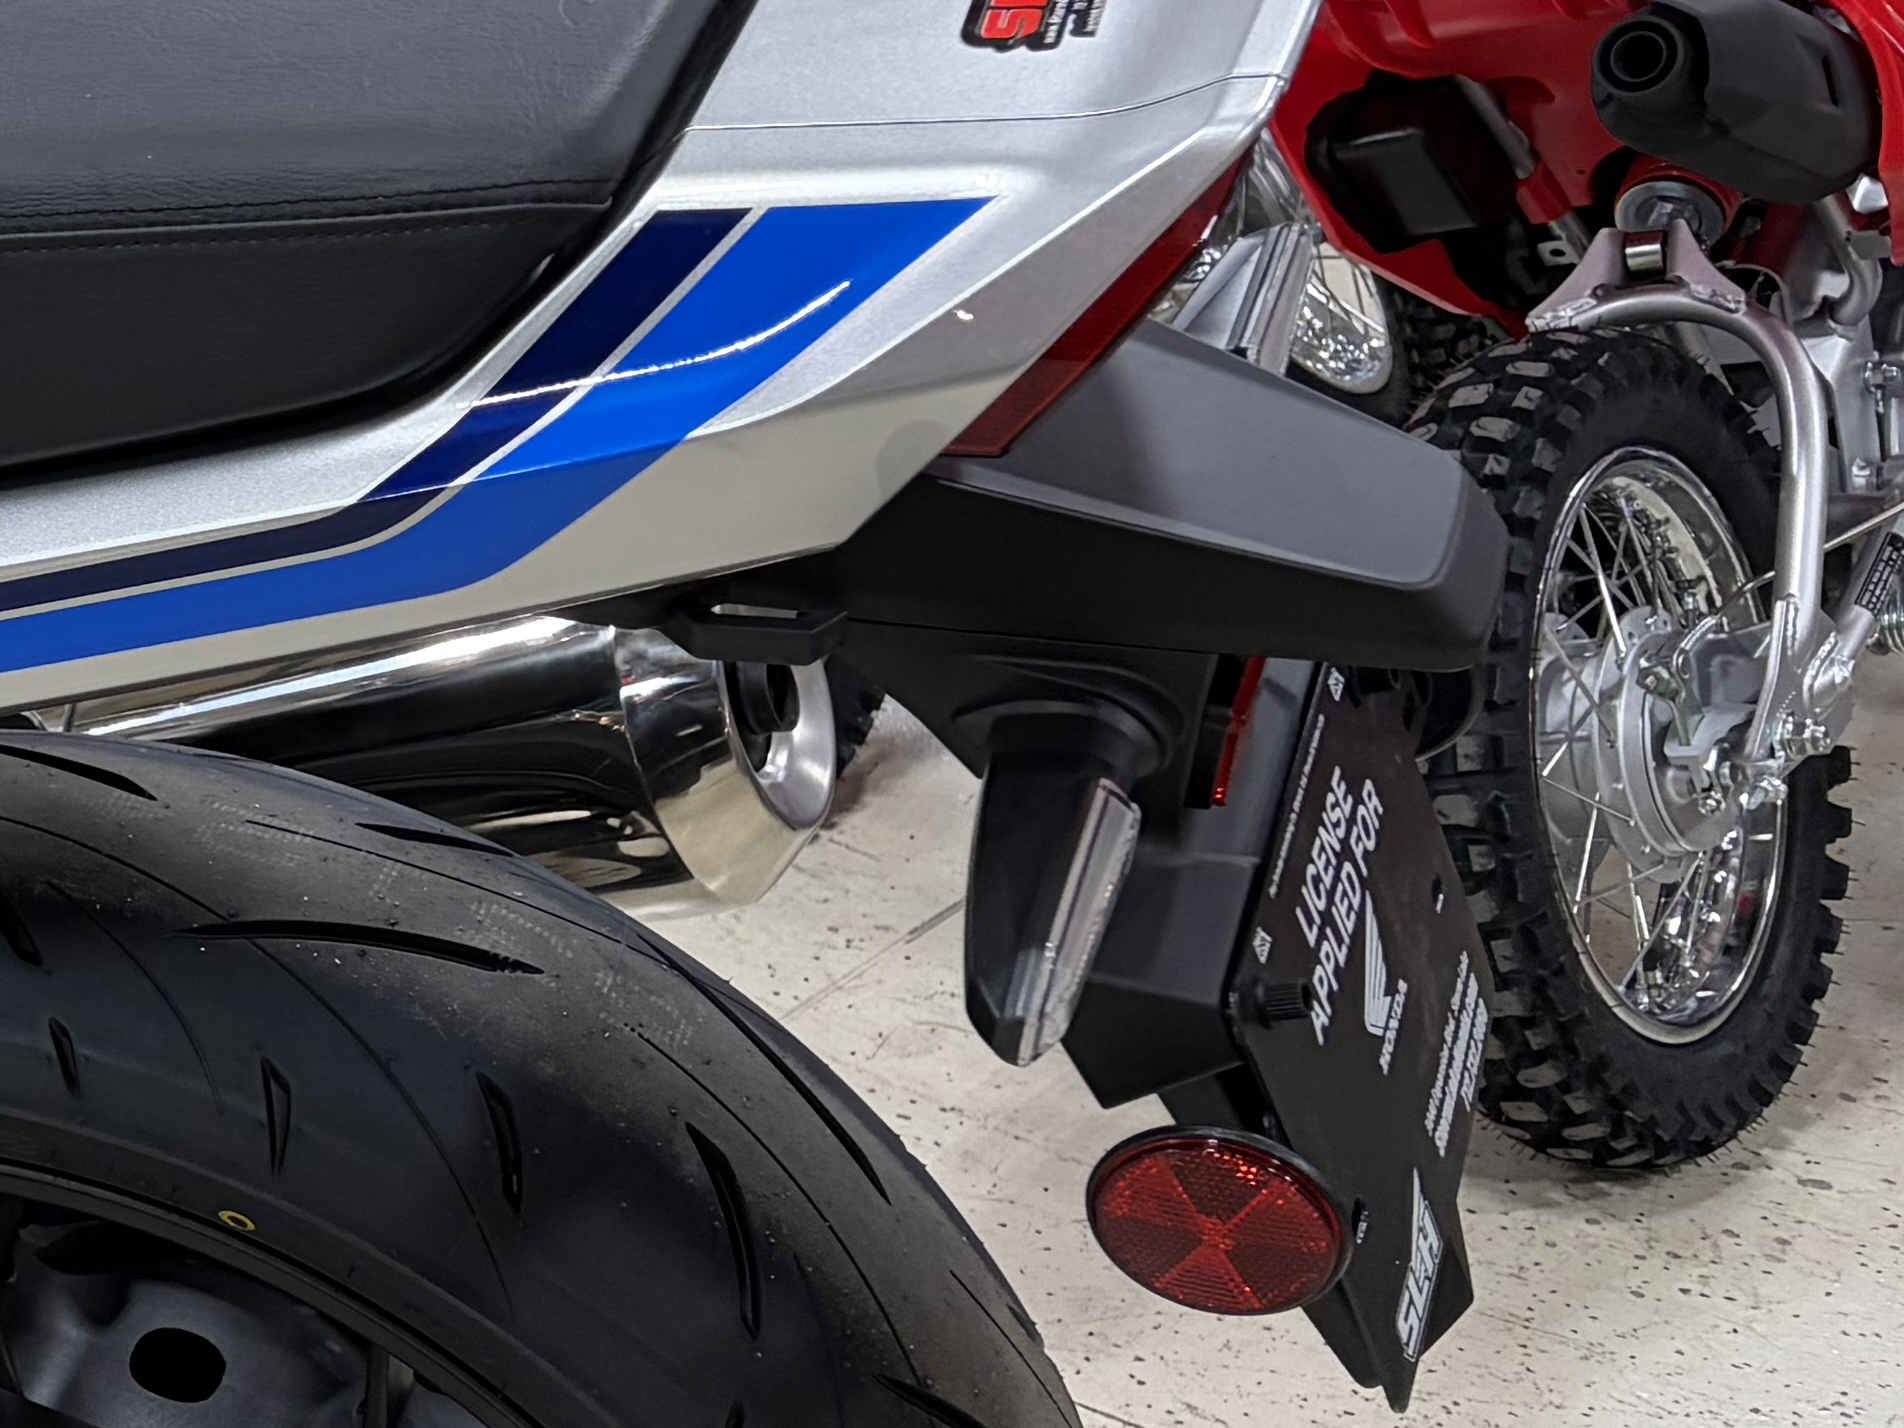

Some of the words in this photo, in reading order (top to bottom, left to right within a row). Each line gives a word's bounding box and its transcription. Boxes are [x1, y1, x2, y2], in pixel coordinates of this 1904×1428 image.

[1294, 765, 1355, 948] LICENSE
[1309, 860, 1362, 1047] APPLIED
[1349, 777, 1385, 878] FOR
[1379, 977, 1409, 1076] HONDA
[1395, 1199, 1444, 1363] SLH
